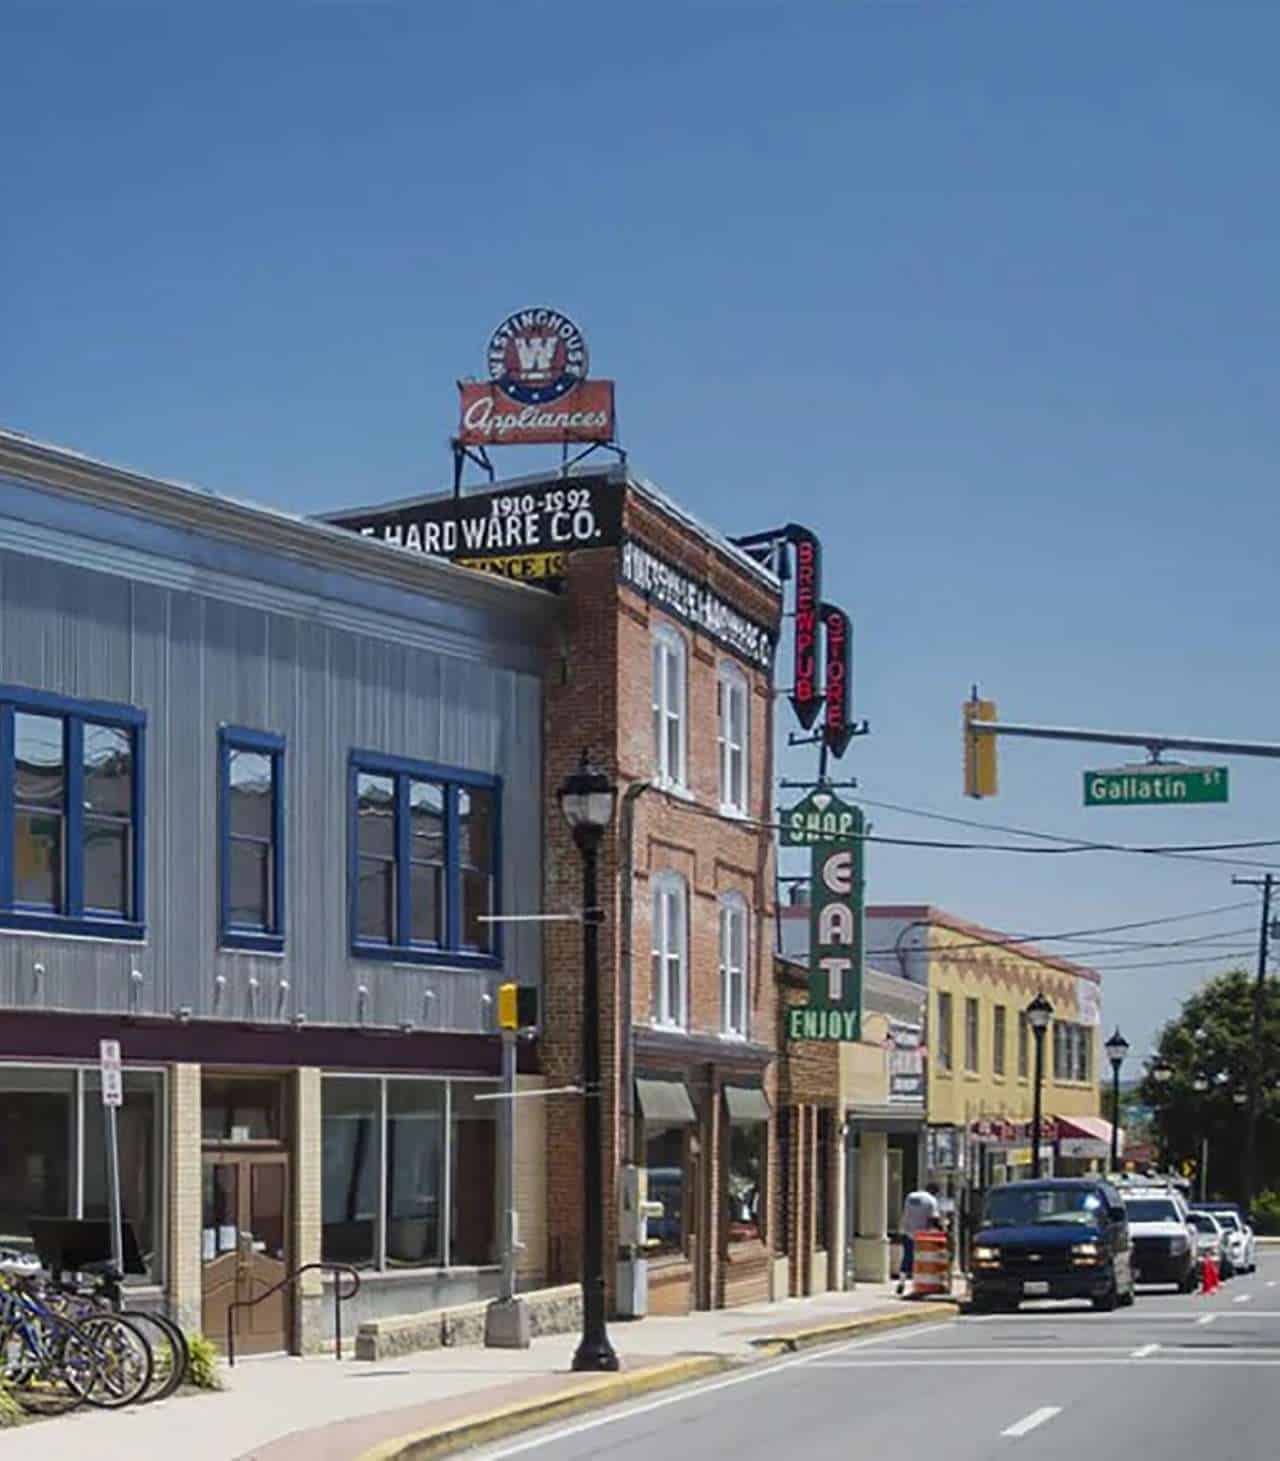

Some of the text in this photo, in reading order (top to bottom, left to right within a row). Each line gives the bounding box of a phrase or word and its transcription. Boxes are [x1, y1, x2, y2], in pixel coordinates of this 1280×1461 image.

[489, 311, 583, 380] WESTINGHOUSE
[464, 397, 607, 436] Appliances
[384, 510, 602, 553] HARDWARE CO.
[469, 556, 536, 578] INCE
[826, 612, 845, 727] STORE
[1090, 776, 1187, 800] Gallatin
[790, 812, 853, 843] SHOP
[818, 851, 854, 1000] EAT
[790, 1009, 858, 1040] ENJOY
